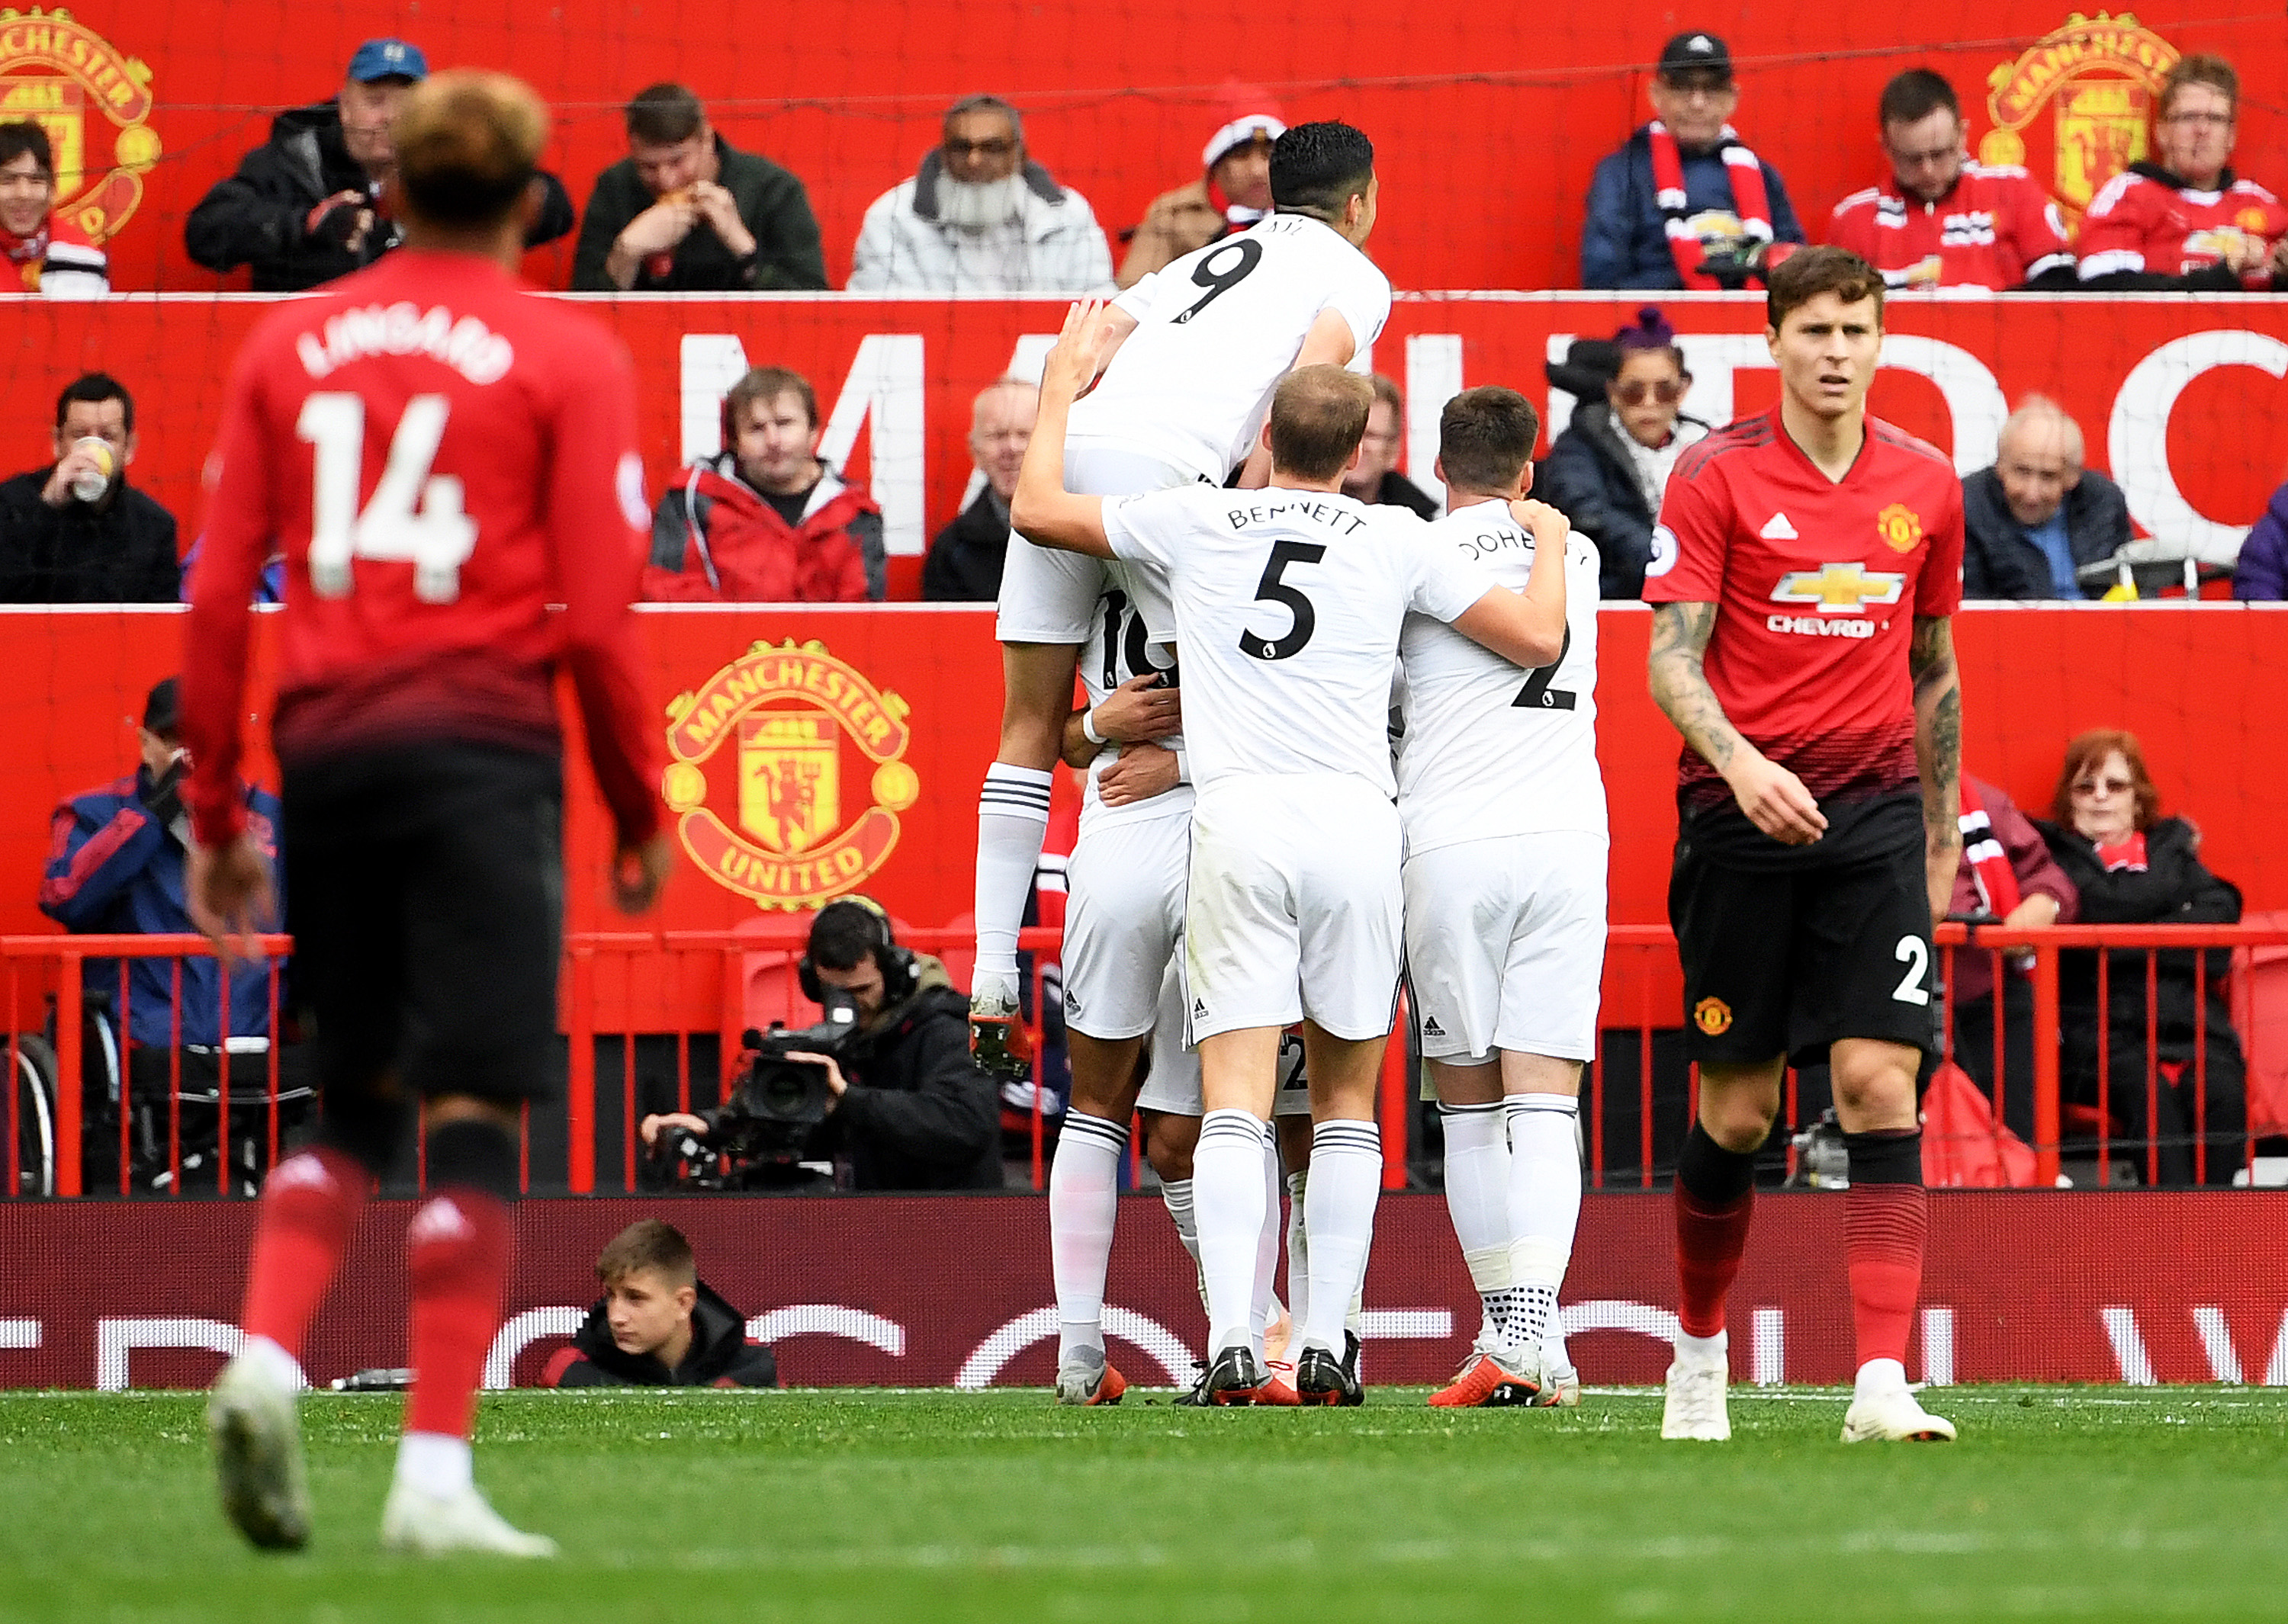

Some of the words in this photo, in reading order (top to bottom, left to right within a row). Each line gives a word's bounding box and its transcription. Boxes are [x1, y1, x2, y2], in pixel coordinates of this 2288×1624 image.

[1169, 238, 1263, 324] 9
[294, 390, 481, 605] 14
[1228, 502, 1367, 535] BENNETT
[1239, 540, 1328, 661] 5
[686, 660, 891, 745] MANCHESTER
[720, 846, 864, 892] UNITED
[1891, 935, 1930, 1006] 2
